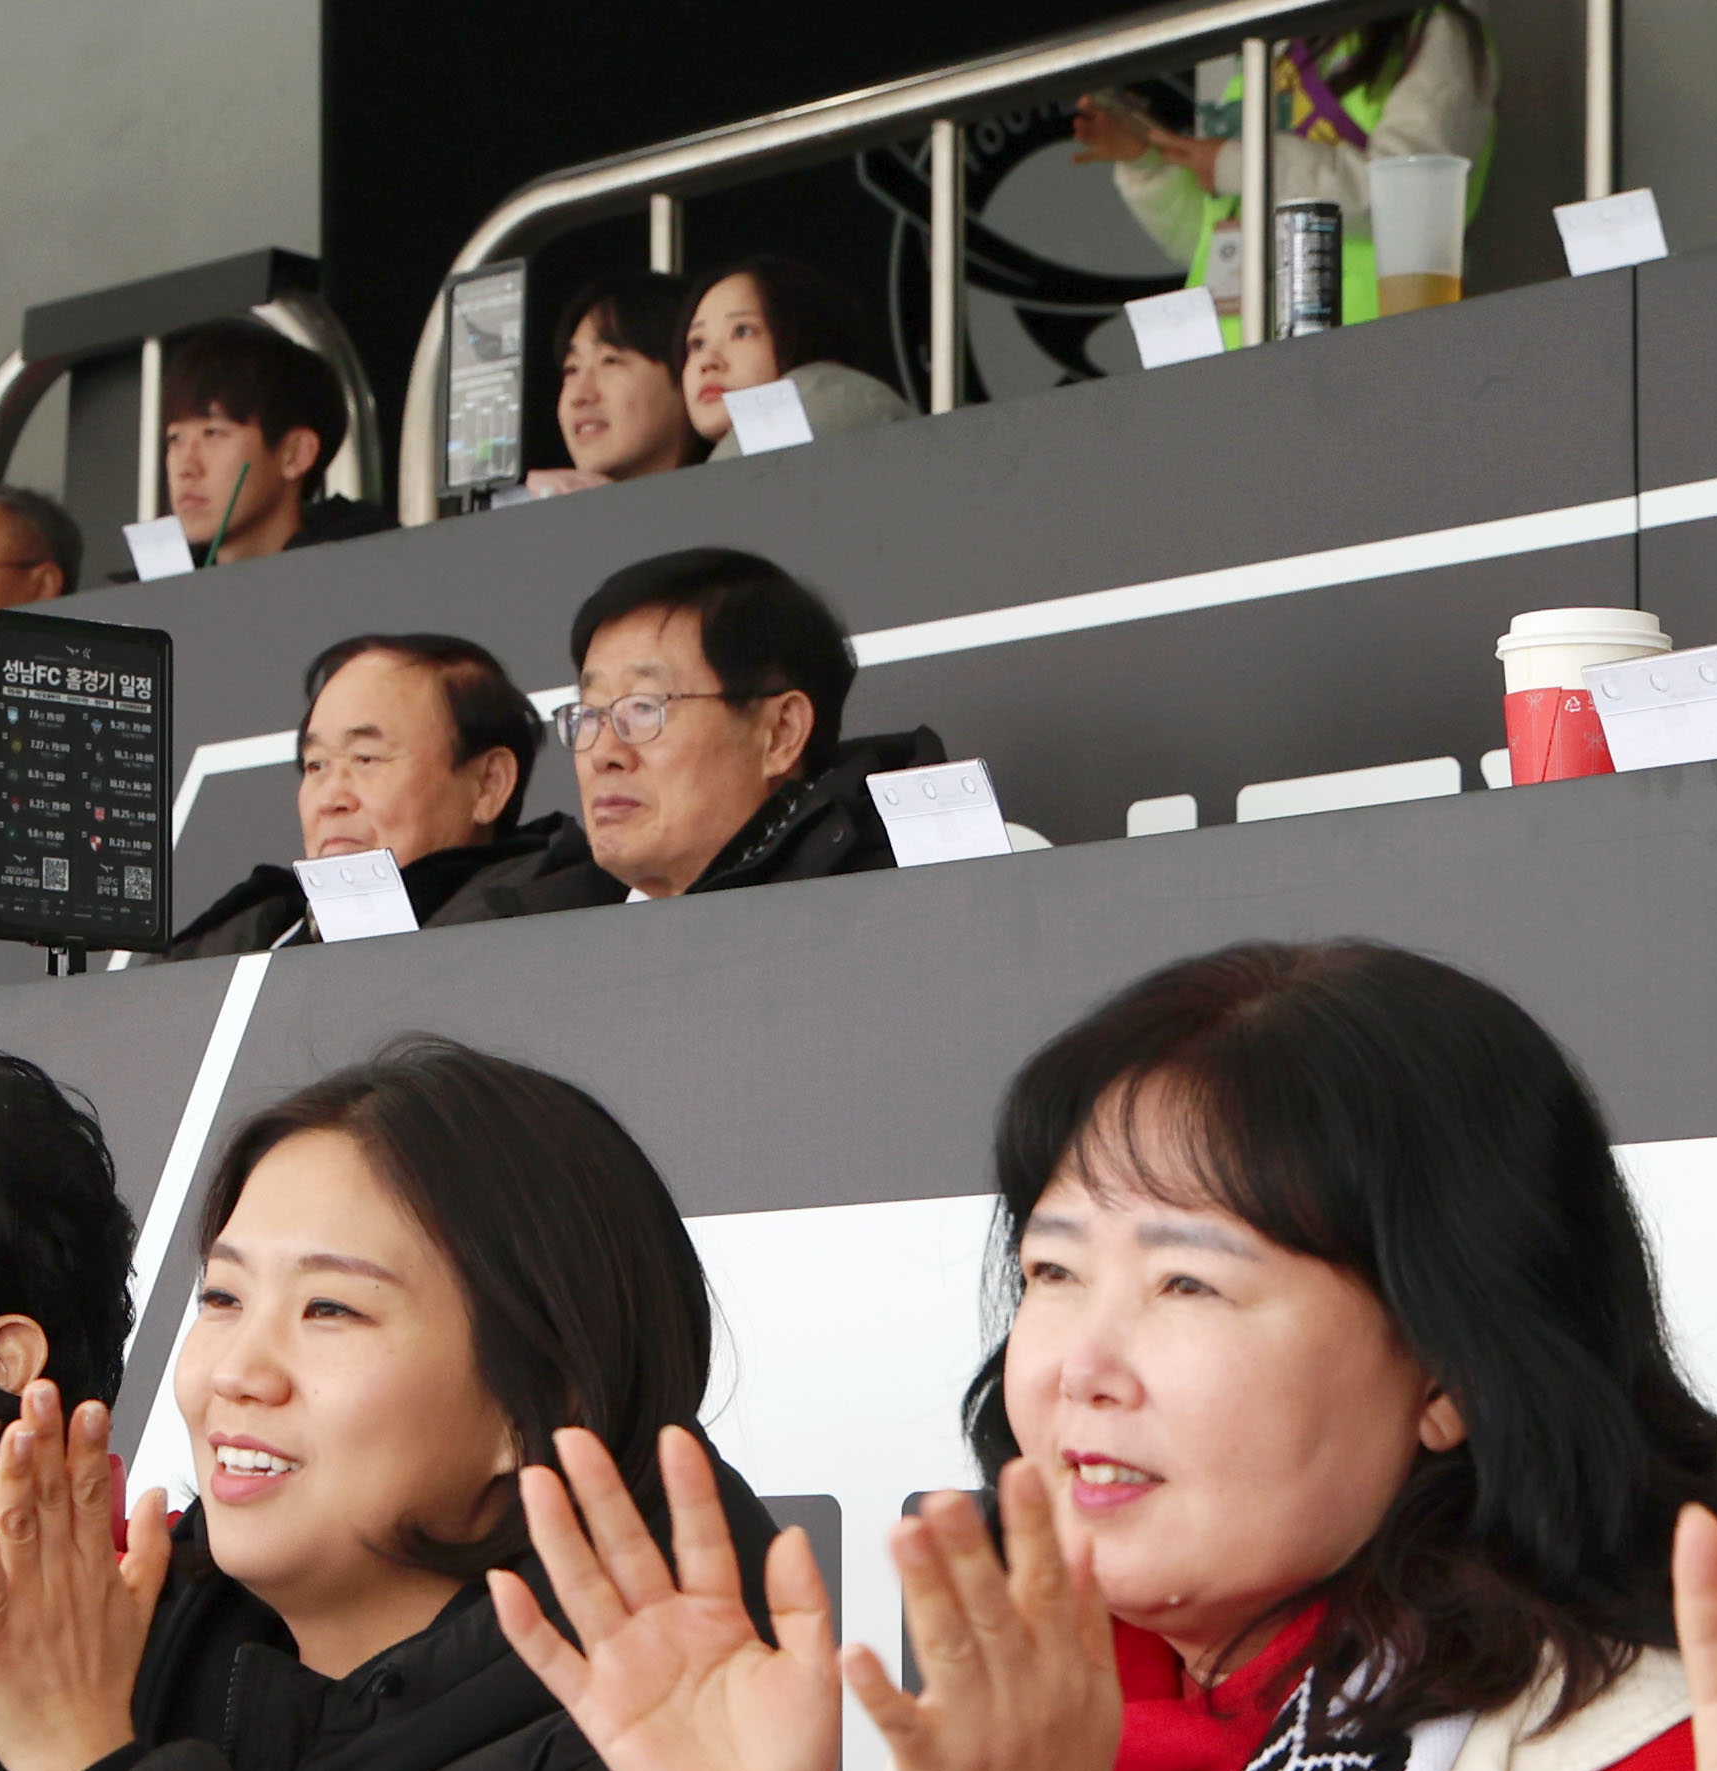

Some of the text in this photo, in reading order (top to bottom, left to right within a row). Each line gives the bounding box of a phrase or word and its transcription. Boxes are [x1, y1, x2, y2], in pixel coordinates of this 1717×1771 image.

[2, 658, 62, 687] 성남FC
[65, 667, 115, 696] 홈경기
[119, 674, 153, 700] 일정
